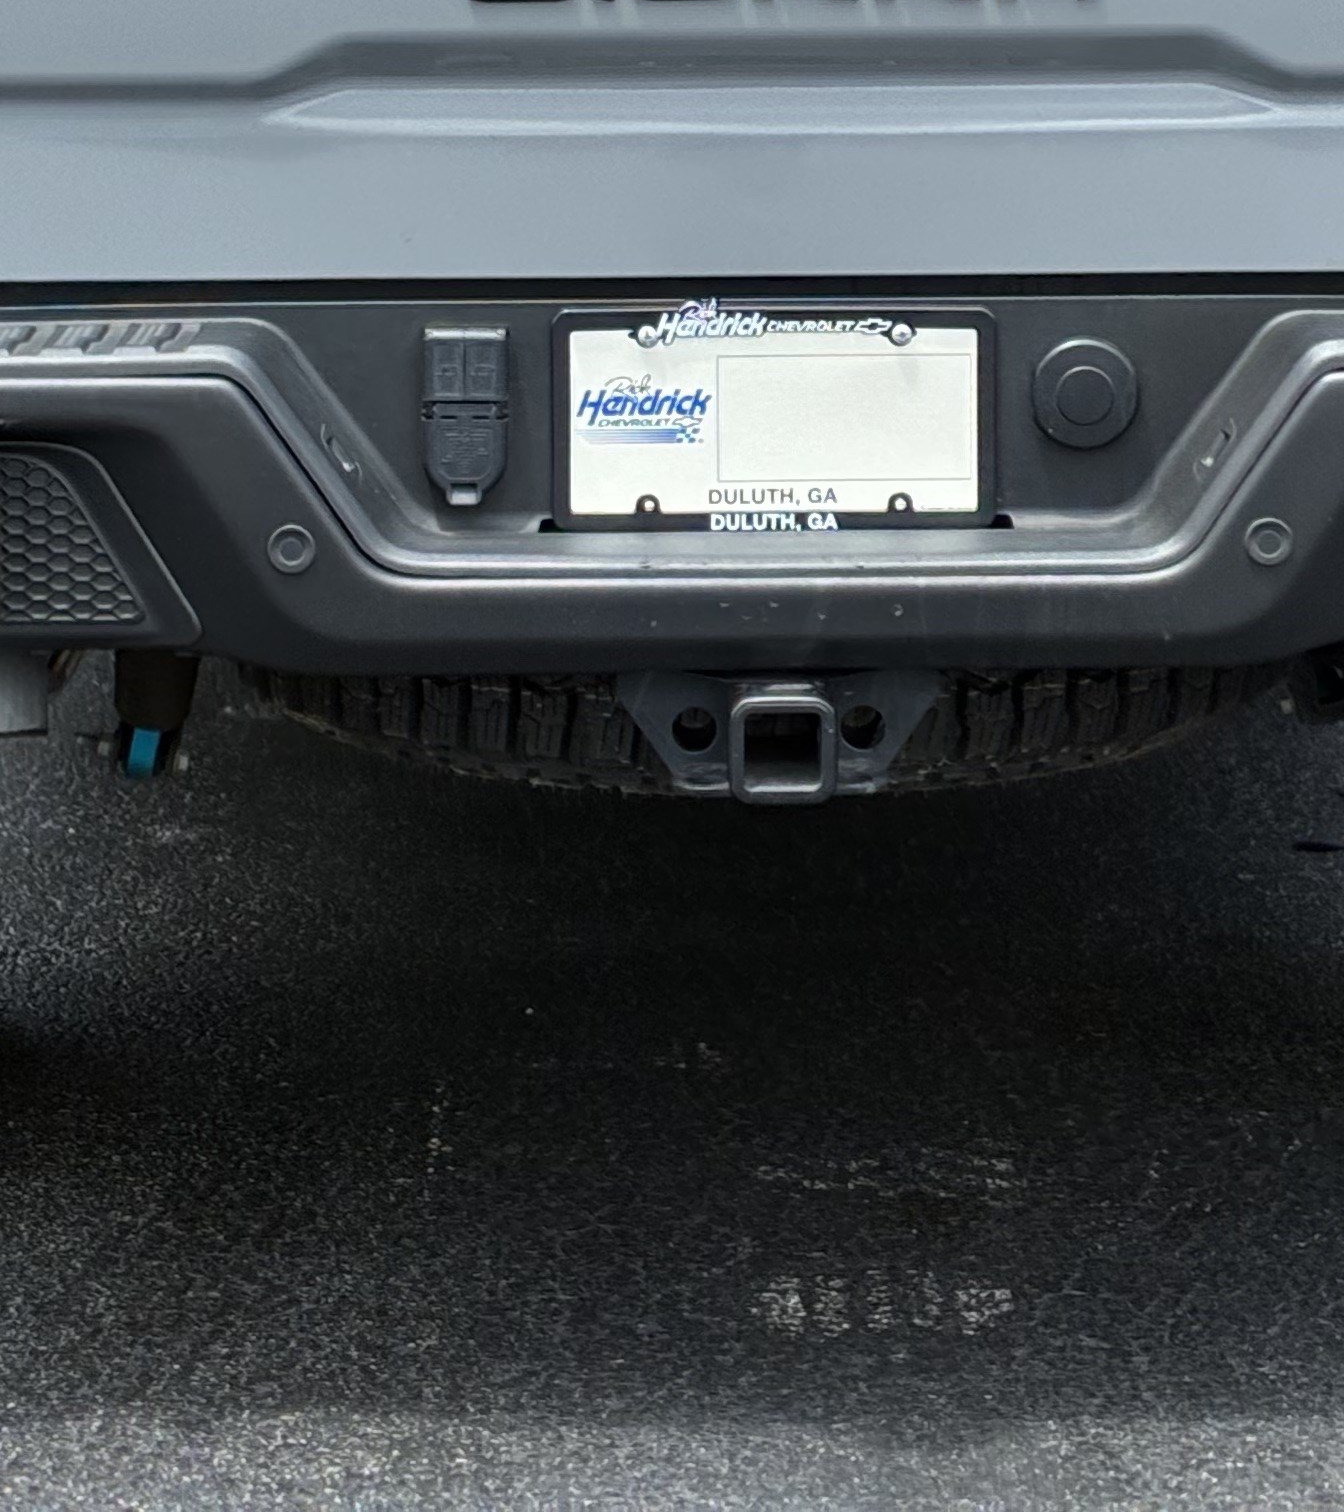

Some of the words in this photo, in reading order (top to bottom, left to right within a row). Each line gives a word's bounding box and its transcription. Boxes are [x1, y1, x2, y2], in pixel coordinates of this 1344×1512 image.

[657, 311, 768, 346] Hendrick
[766, 319, 855, 334] CHEVROLET
[576, 387, 712, 426] Hendrick
[598, 418, 673, 428] CHEVROLET
[708, 488, 802, 506] DULUTH,
[807, 487, 838, 504] GA
[710, 512, 802, 532] DULUTH,
[807, 512, 839, 531] GA
